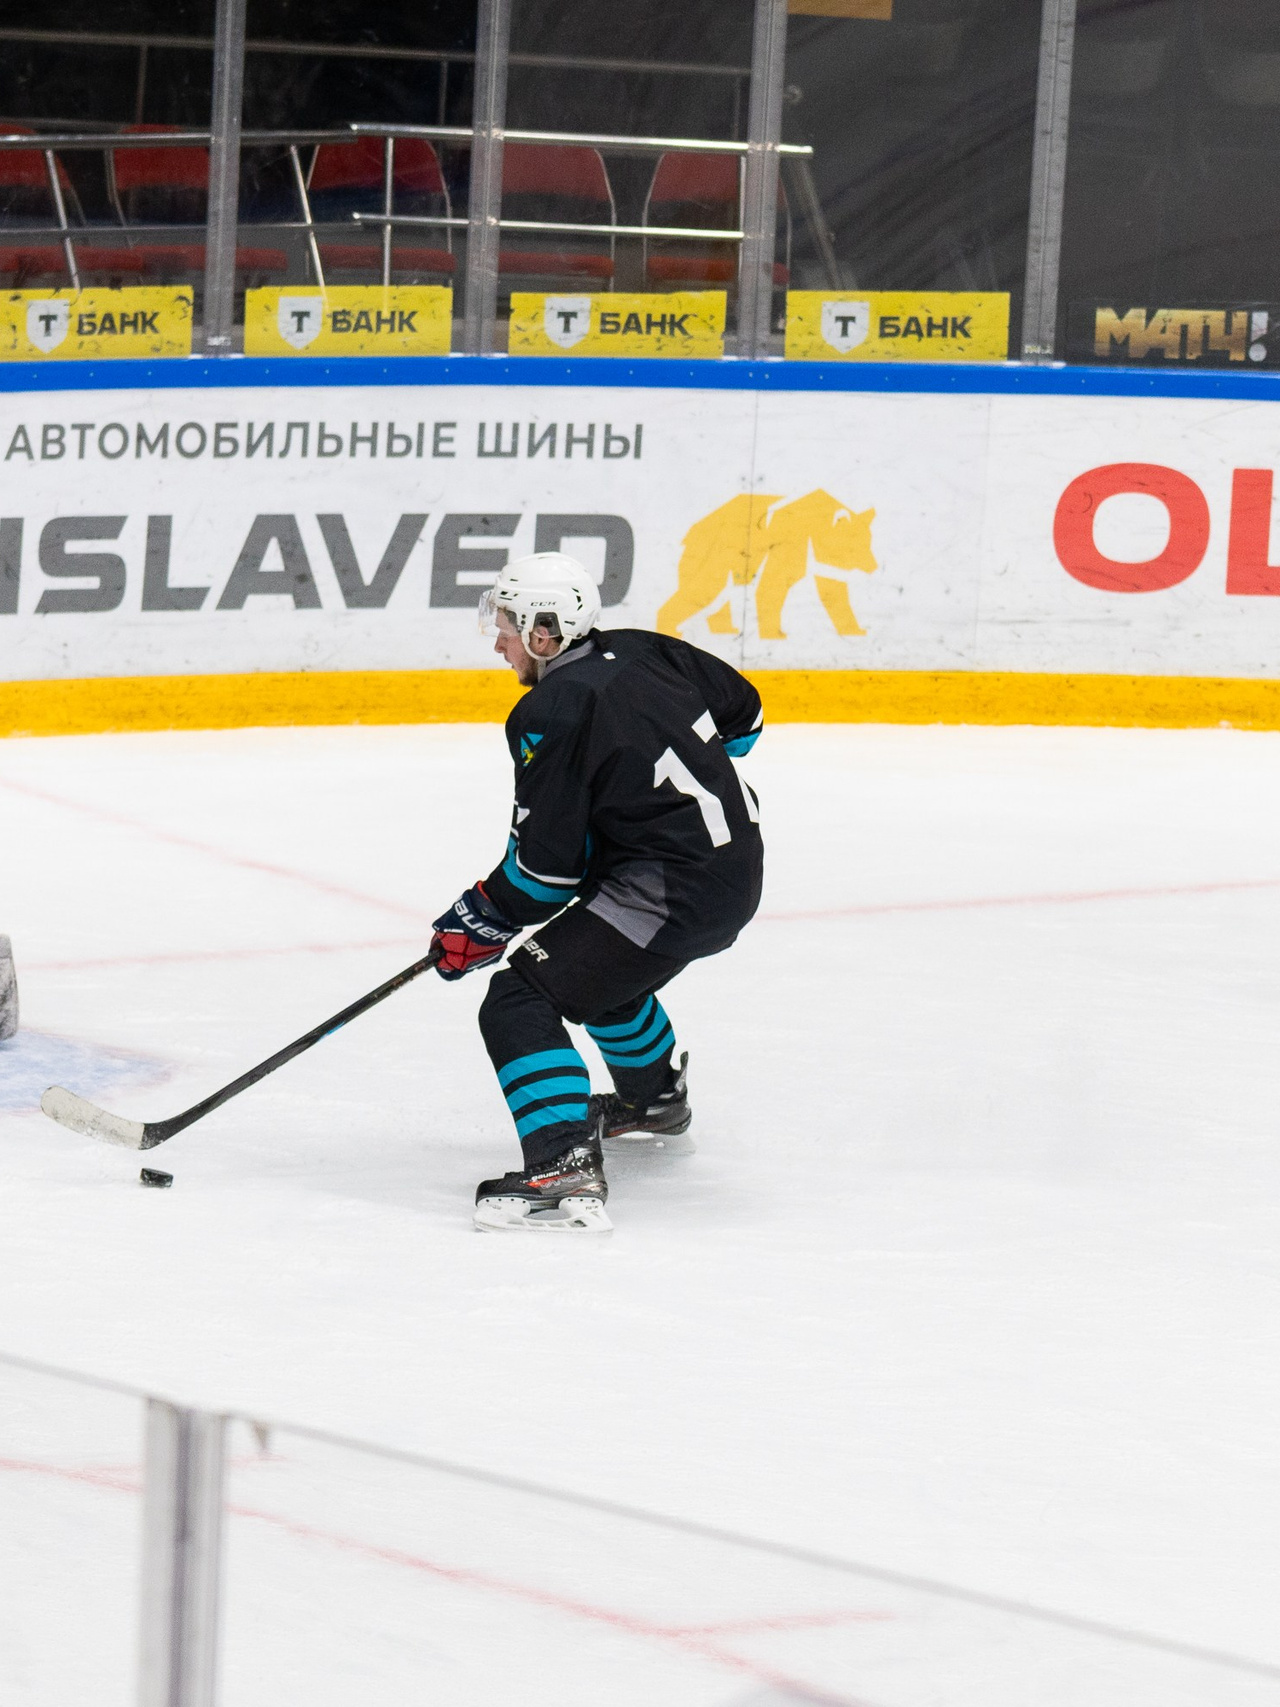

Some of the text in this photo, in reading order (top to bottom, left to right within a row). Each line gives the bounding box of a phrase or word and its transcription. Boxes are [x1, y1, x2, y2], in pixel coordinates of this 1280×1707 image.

[76, 312, 159, 335] БАНК
[332, 309, 417, 332] БАНК
[600, 312, 689, 335] БАНК
[879, 316, 971, 339] БАНК
[4, 421, 643, 461] АВТОМОБИЛЬНЫЕ ШИНЫ
